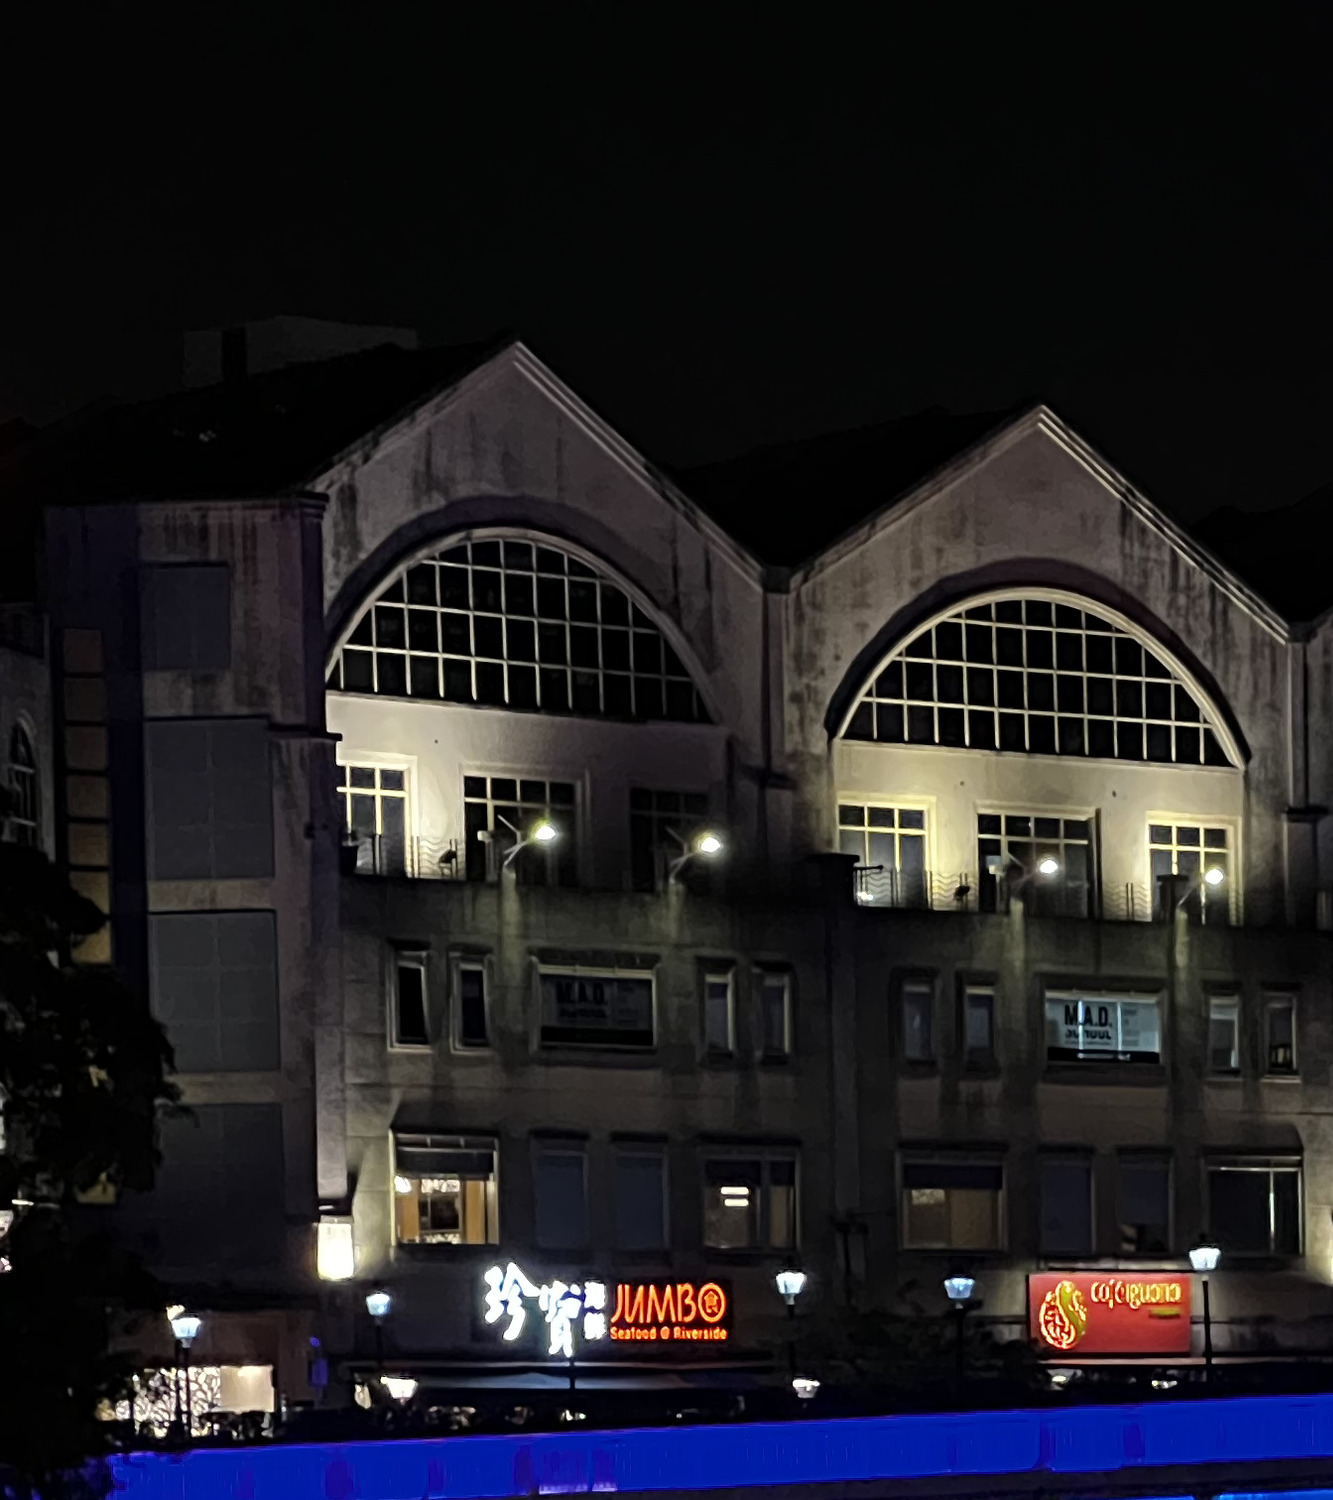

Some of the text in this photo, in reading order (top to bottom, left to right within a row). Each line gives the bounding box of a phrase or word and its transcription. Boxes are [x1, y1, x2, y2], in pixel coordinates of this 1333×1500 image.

[610, 1282, 726, 1323] JUMBO
[610, 1326, 657, 1340] Seafood
[673, 1326, 728, 1340] Riverside
